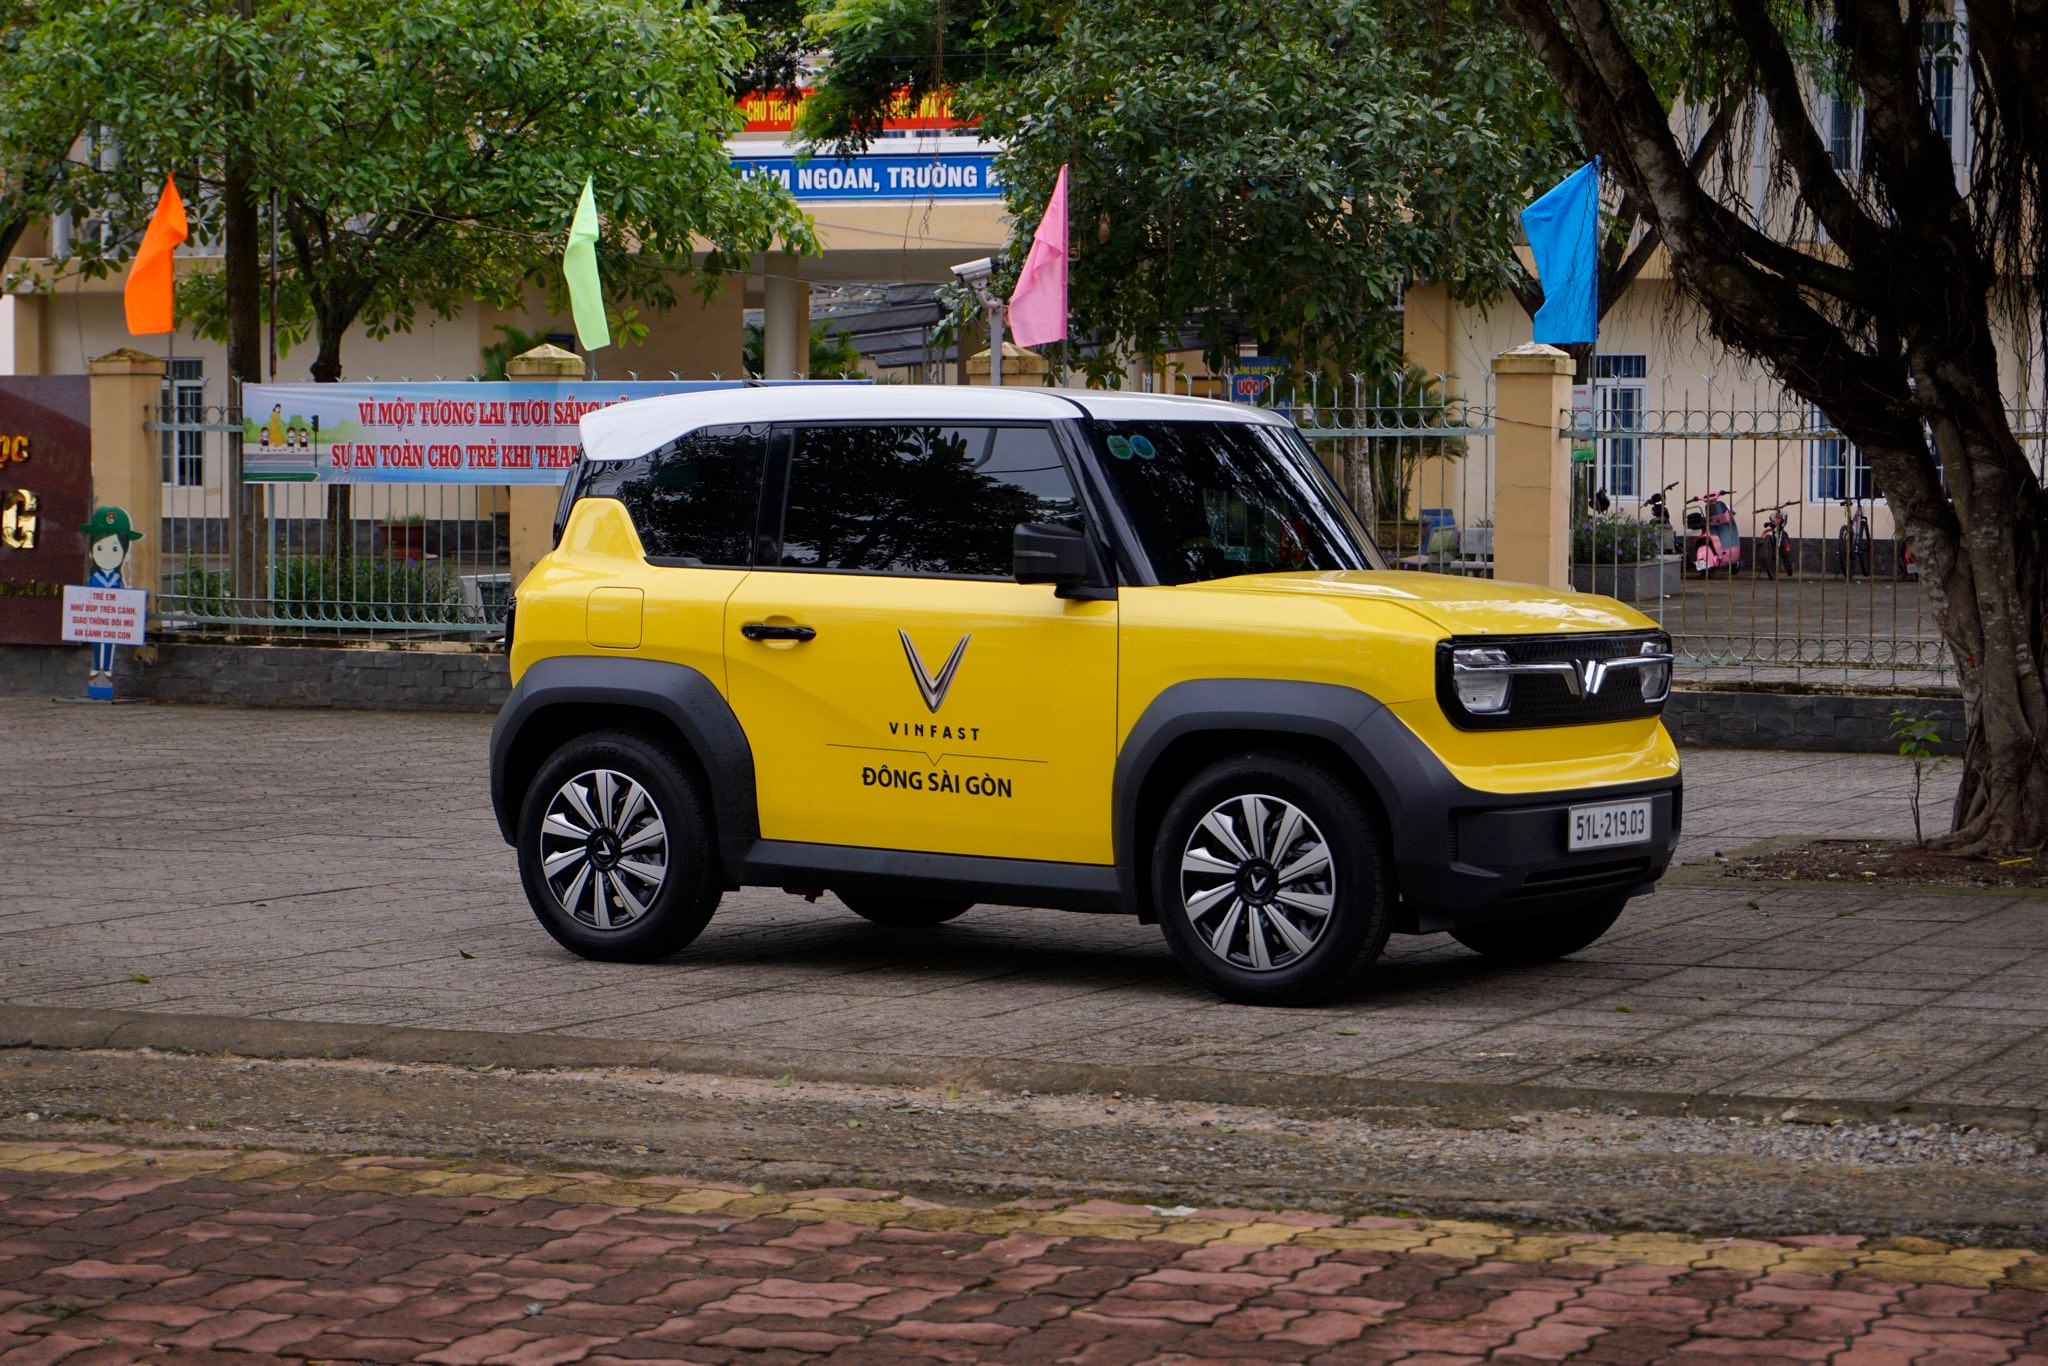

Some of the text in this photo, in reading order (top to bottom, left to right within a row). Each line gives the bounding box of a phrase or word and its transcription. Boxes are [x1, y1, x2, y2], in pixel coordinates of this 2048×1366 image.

[798, 167, 880, 192] NGOAN,
[887, 161, 978, 189] TRƯỜNG
[358, 396, 376, 426] VÌ
[378, 396, 416, 431] MỘT
[478, 401, 506, 426] LAI
[509, 398, 550, 426] TƯƠI
[331, 441, 352, 473] SỰ
[354, 444, 377, 468] AN
[379, 438, 424, 468] TOÀN
[427, 444, 463, 468] CHO
[465, 438, 498, 468] TRẺ
[501, 445, 532, 468] KHI
[889, 721, 980, 741] VINFAST
[862, 764, 1012, 798] ĐÔNG SÀI GÒN
